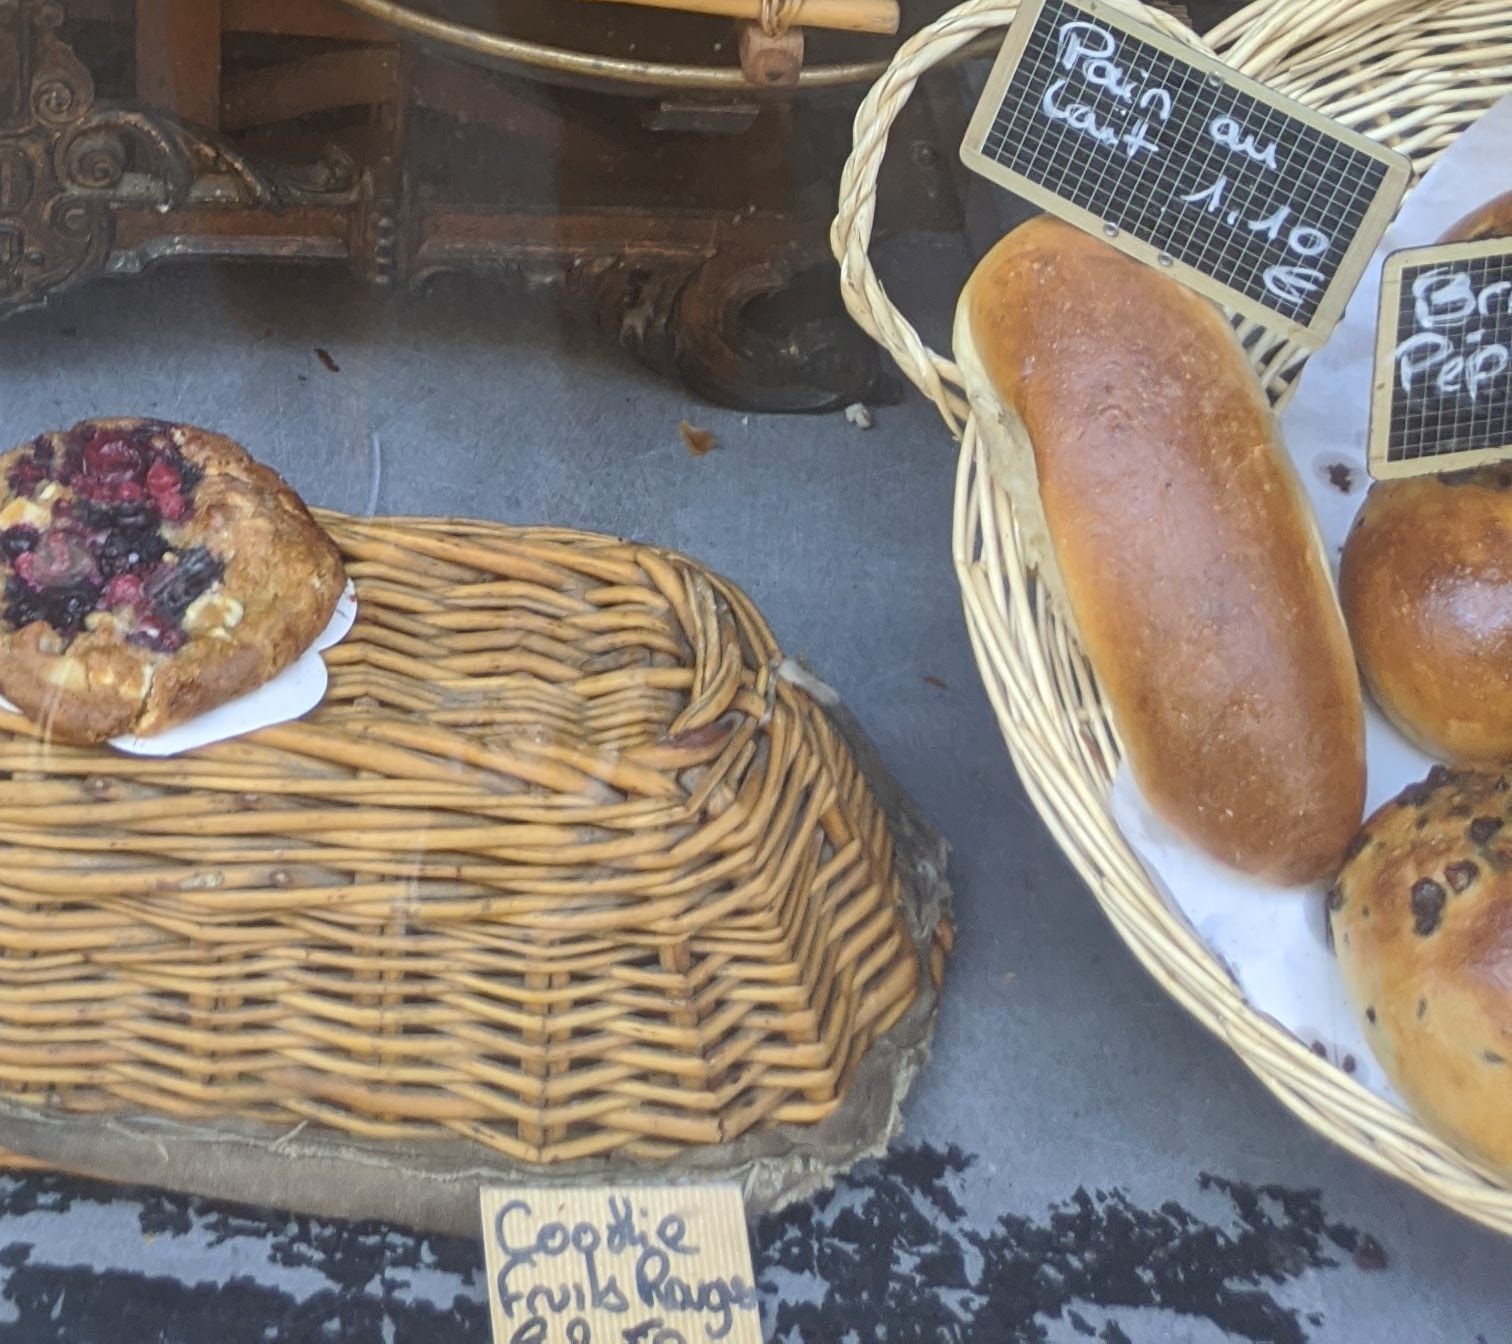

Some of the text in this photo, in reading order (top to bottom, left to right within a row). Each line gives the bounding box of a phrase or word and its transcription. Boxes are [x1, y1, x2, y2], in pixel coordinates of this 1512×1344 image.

[1042, 78, 1160, 158] Lait
[1056, 21, 1277, 170] Pain au
[1412, 267, 1512, 329] Br
